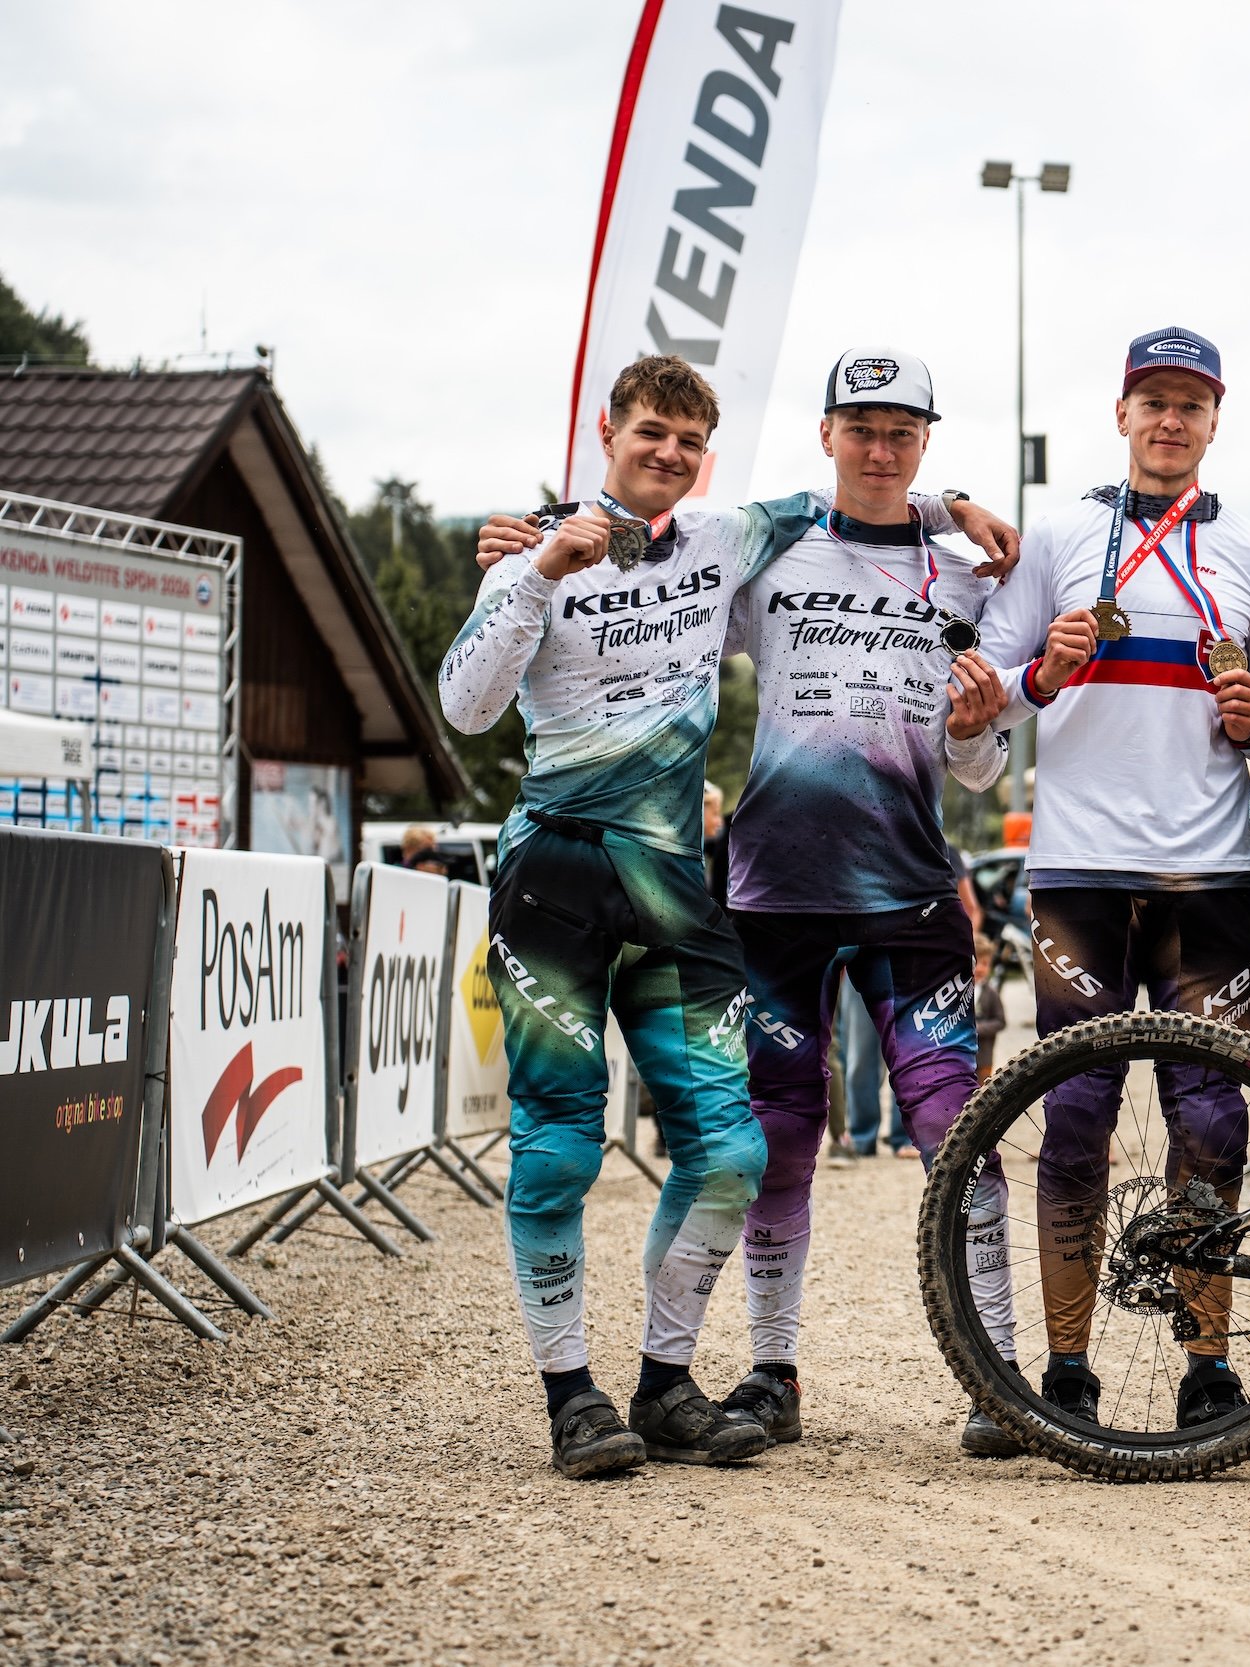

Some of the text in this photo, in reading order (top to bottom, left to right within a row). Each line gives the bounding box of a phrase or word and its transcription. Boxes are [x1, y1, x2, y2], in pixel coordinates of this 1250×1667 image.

[637, 3, 796, 366] KENDA
[1156, 343, 1201, 355] SCHWALBE
[1142, 518, 1172, 551] WELDTITE
[1121, 559, 1136, 579] KENDA
[563, 564, 721, 619] KELLYS
[591, 605, 718, 657] Factory Team
[789, 617, 943, 653] Factory Team
[789, 671, 830, 680] SCHWALBE
[904, 677, 935, 694] KLS
[606, 687, 646, 703] KS
[795, 689, 832, 701] KS
[850, 695, 887, 712] PRO
[898, 695, 936, 712] SHIMANO
[791, 708, 835, 718] Panasonic
[911, 714, 931, 727] BMZ
[201, 887, 304, 1032] PosAm
[490, 932, 600, 1052] KELLYS
[960, 1153, 987, 1215] DT SWISS
[746, 1251, 789, 1262] SHIMANO
[533, 1269, 576, 1289] SHIMANO
[750, 1267, 784, 1279] KS
[541, 1287, 575, 1307] KS
